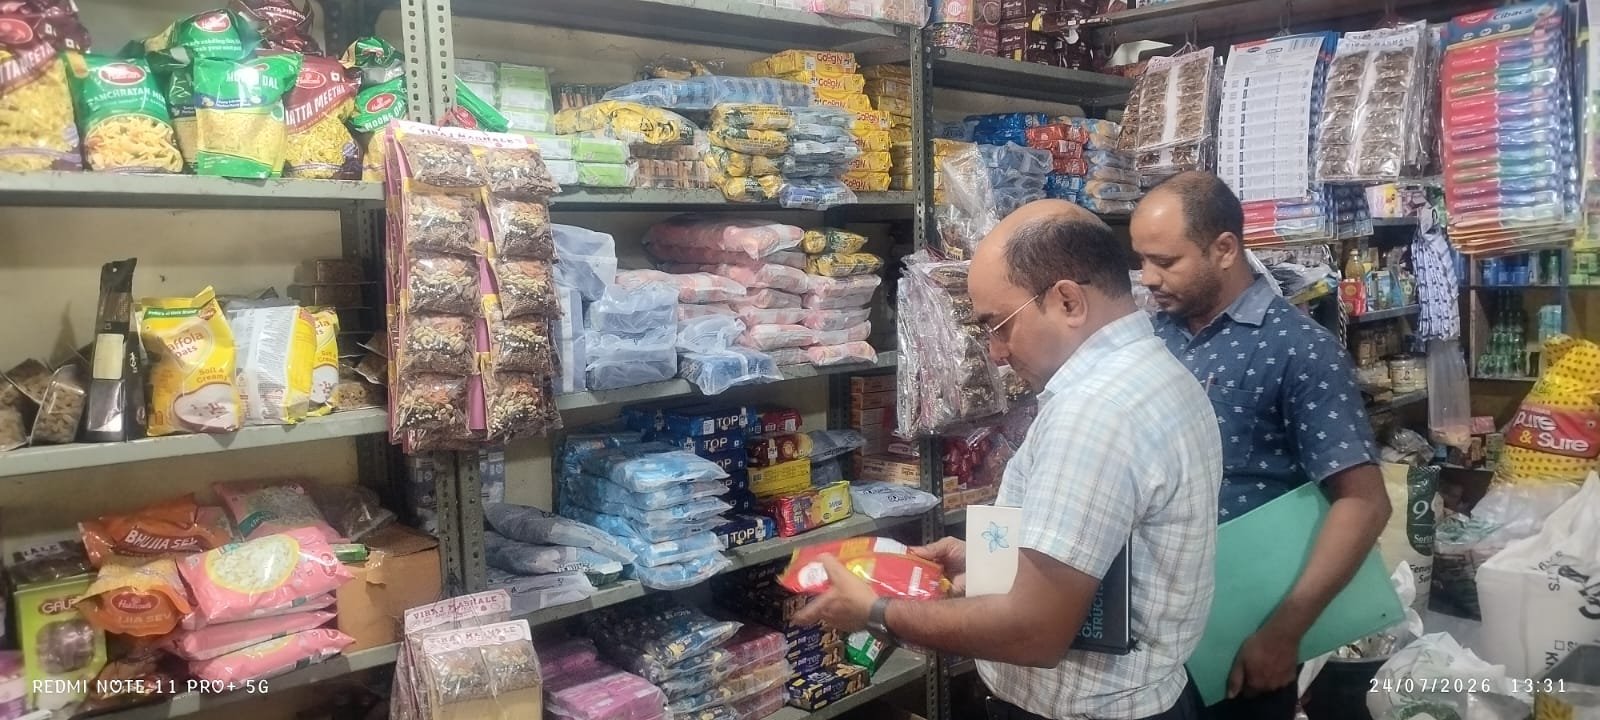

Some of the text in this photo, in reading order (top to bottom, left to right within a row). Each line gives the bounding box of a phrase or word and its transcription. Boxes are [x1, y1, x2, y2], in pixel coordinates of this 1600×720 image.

[314, 84, 346, 112] MEETHA
[167, 331, 205, 351] affola
[716, 415, 739, 429] TOP
[1513, 411, 1558, 431] Pure
[703, 437, 728, 450] TOP
[1520, 430, 1590, 452] & Sure
[716, 458, 732, 469] OP
[1412, 500, 1430, 520] 9
[124, 529, 169, 550] BHUJIA
[730, 527, 755, 544] TOP
[42, 598, 75, 614] GAU
[414, 606, 444, 619] VIRAJ
[1092, 586, 1104, 639] STRUCT
